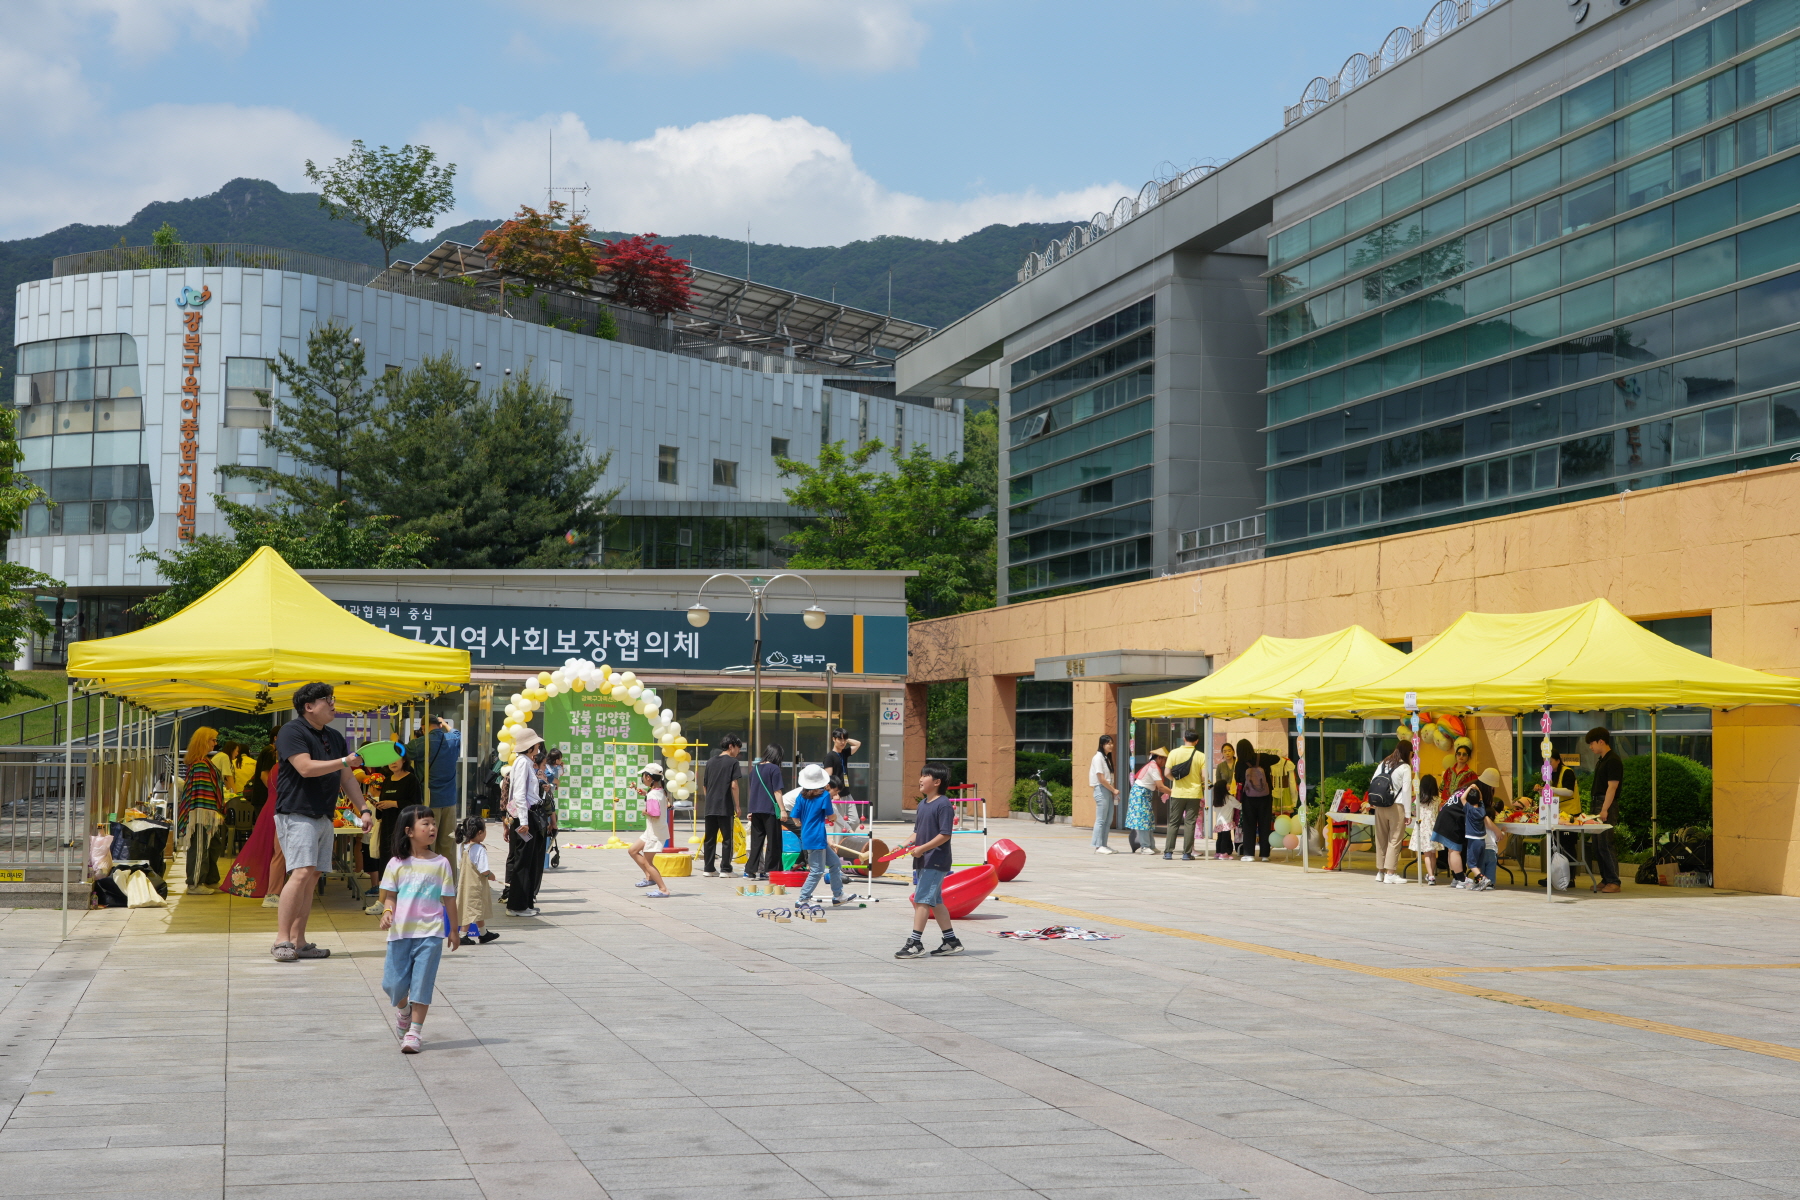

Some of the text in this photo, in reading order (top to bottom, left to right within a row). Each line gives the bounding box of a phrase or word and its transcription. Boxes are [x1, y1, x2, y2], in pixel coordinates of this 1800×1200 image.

[176, 311, 203, 543] 강북구육아종합지원센터
[341, 605, 433, 620] 관협력의 중심
[372, 624, 699, 662] 구지역사회보장협의체
[791, 655, 826, 664] 강북구
[569, 710, 630, 725] 강북 다양한
[569, 725, 630, 738] 가족 한마당
[1541, 718, 1551, 803] 가면체험
